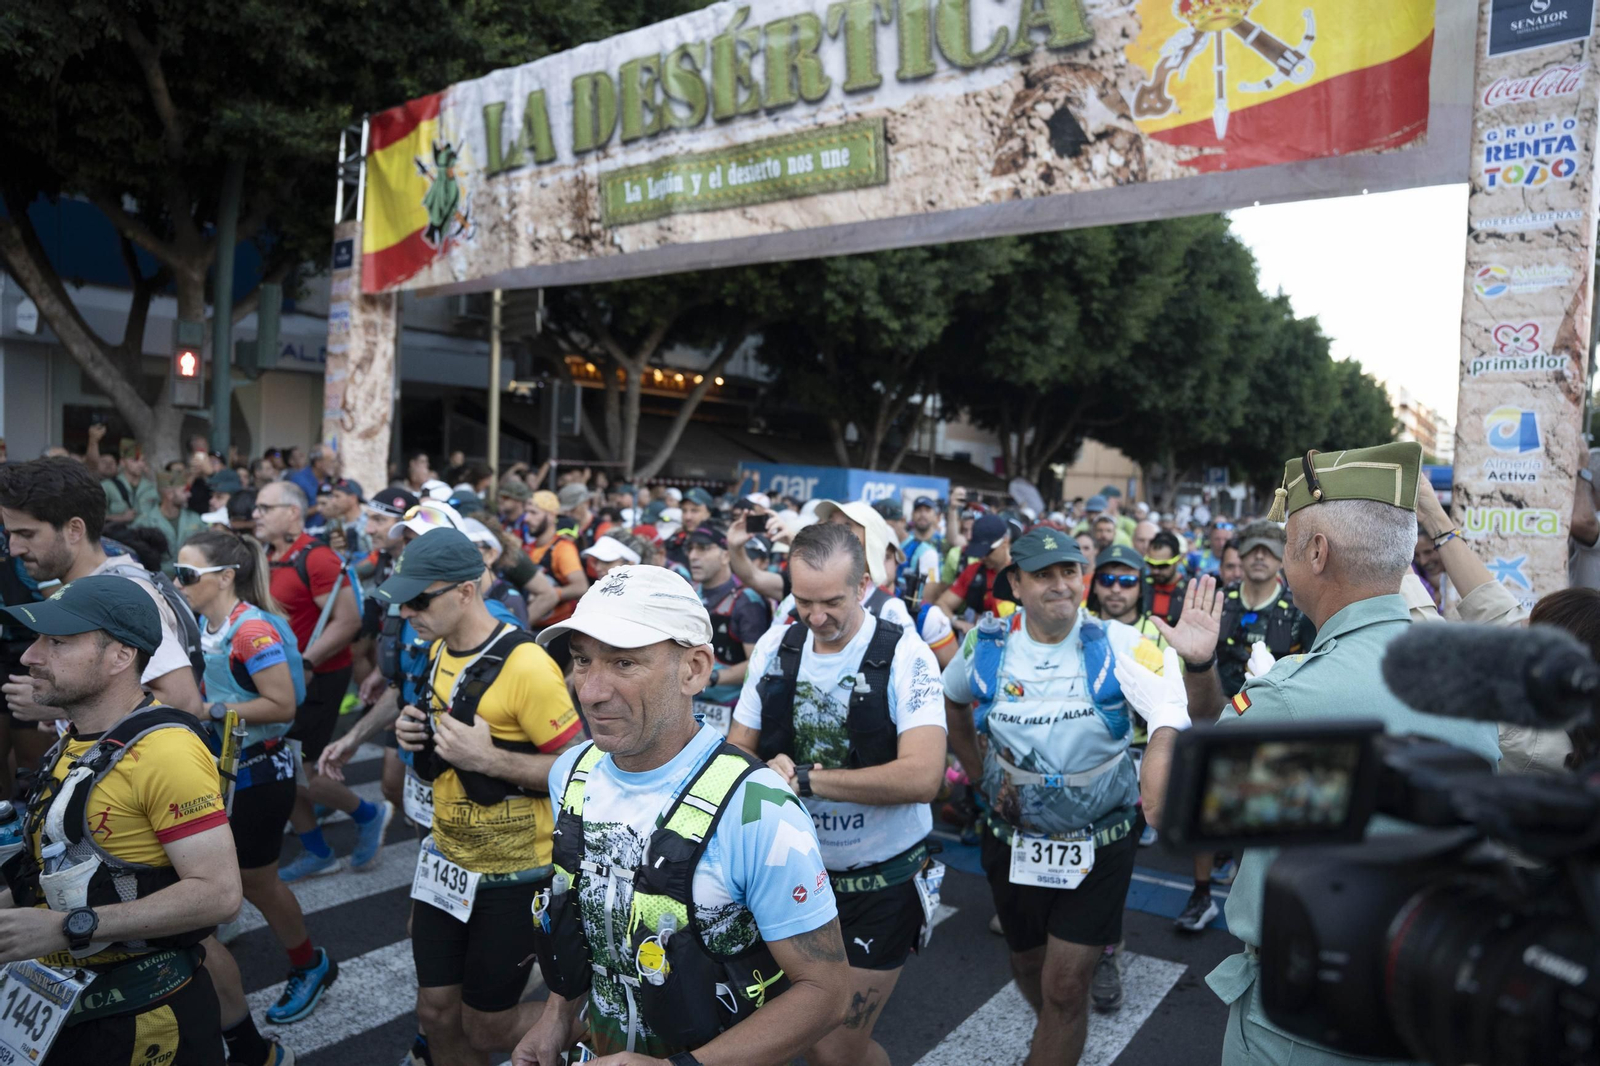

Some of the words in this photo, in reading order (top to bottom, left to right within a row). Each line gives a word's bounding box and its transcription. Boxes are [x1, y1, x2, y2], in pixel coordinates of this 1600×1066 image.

[1510, 10, 1568, 31] SENATOR
[484, 88, 557, 179] LA
[572, 0, 1094, 153] DESÉRTICA
[1487, 119, 1576, 141] GRUPO
[1485, 135, 1577, 163] RENTA
[624, 181, 642, 204] La
[647, 171, 683, 201] Legión
[691, 174, 702, 196] y
[708, 165, 722, 189] el
[728, 158, 781, 186] desierto
[787, 152, 814, 176] nos
[821, 148, 850, 170] une
[1484, 158, 1576, 187] TODO
[1473, 354, 1568, 376] primaflor
[1488, 471, 1536, 482] Activa
[998, 712, 1021, 725] TRAIL
[1062, 707, 1096, 720] ALGAR
[811, 810, 865, 831] ctiva
[1031, 841, 1082, 866] 3173
[433, 860, 468, 895] 1439
[834, 874, 889, 893] TICA
[1, 986, 53, 1042] 1443
